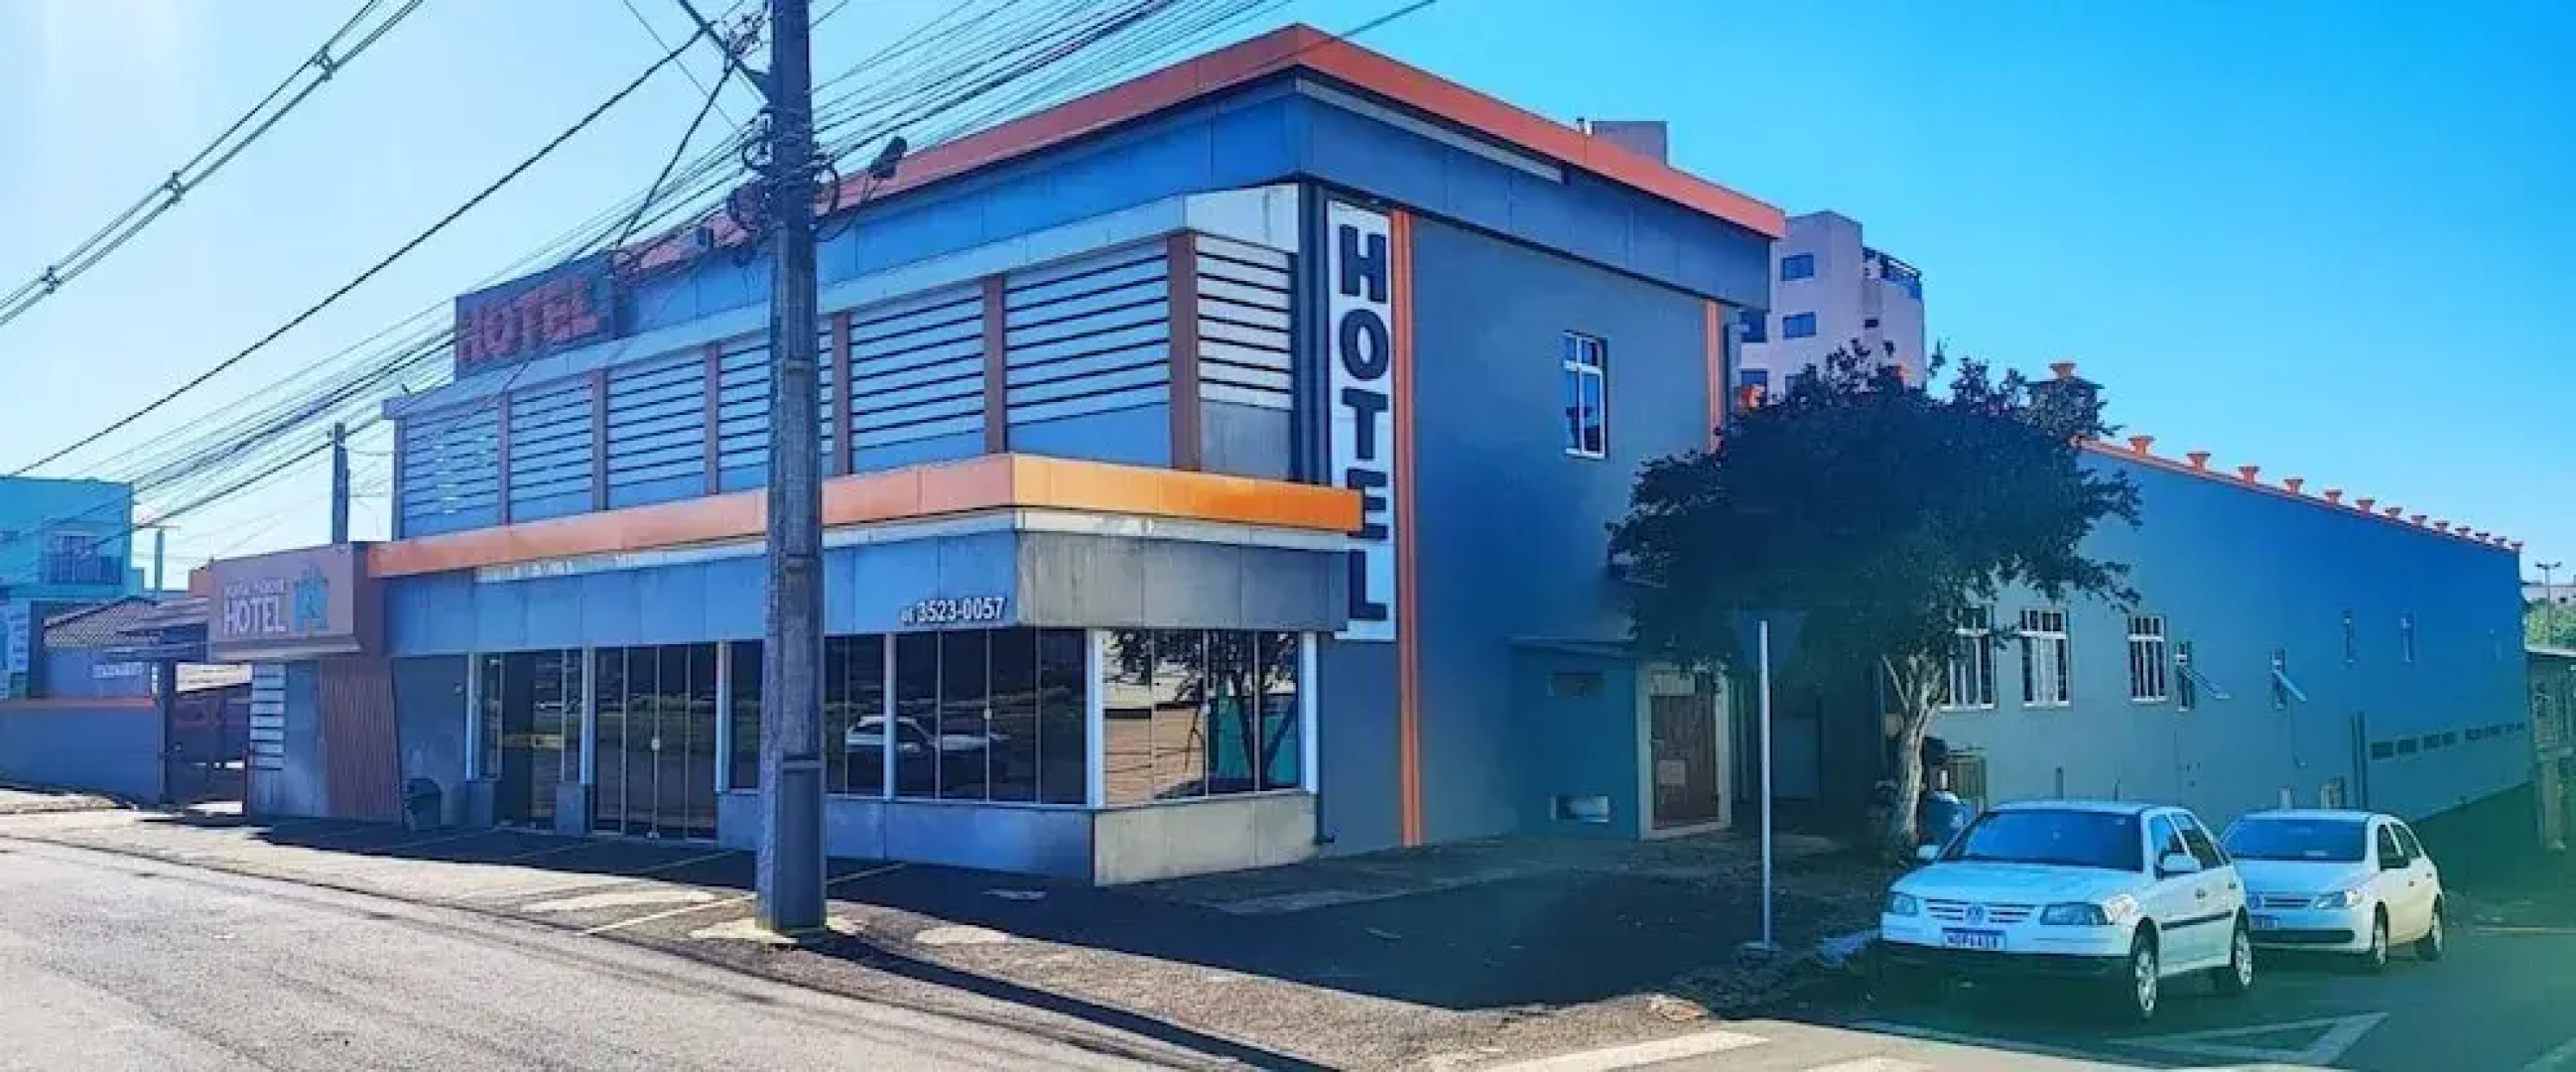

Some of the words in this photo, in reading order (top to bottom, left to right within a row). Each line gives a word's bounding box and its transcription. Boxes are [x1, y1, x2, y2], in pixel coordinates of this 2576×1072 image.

[456, 276, 598, 364] HOTEL
[1340, 224, 1389, 620] HOTEL
[223, 597, 287, 635] HOTEL
[917, 597, 1004, 622] 3523-0057
